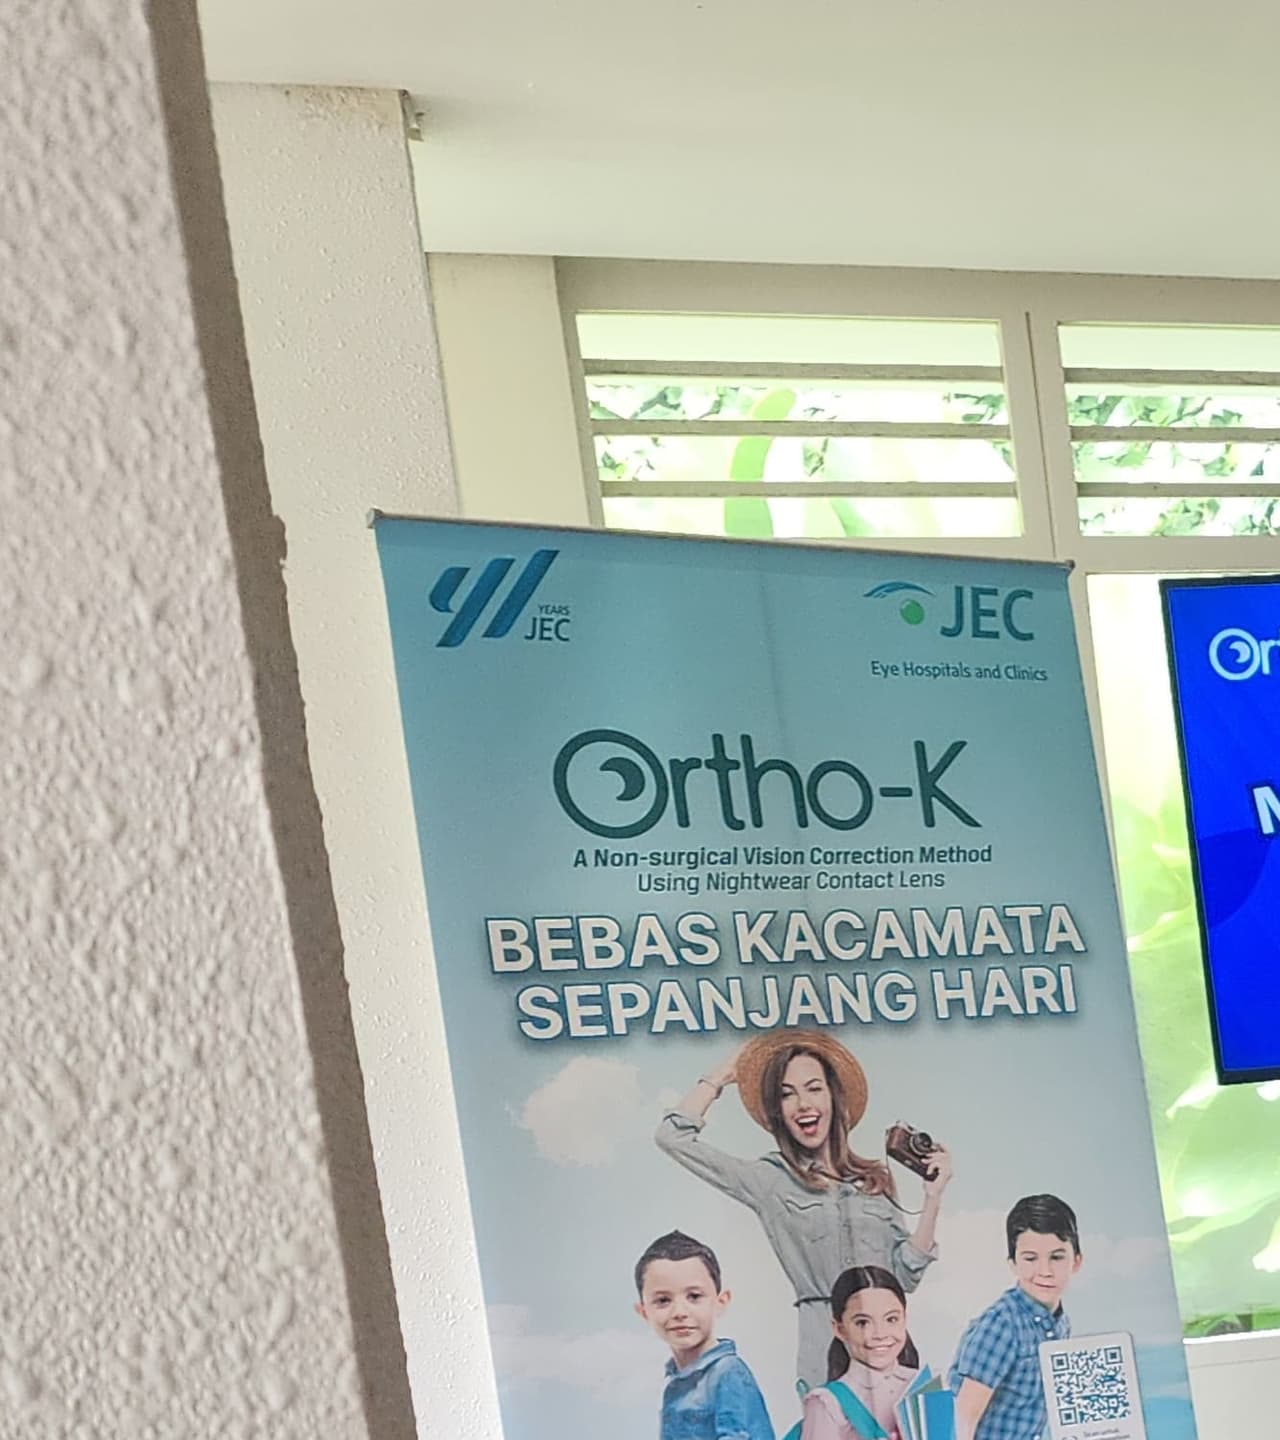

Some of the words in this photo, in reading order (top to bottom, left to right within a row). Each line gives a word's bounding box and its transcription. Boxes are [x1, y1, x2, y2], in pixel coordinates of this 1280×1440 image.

[538, 604, 570, 615] YEARS
[940, 585, 1034, 641] JEC
[524, 617, 570, 641] JEC
[871, 661, 899, 678] Eye
[904, 662, 971, 679] Hospitals
[976, 665, 1000, 679] and
[1005, 665, 1048, 681] Clinics
[553, 729, 983, 839] Ortho-K
[573, 849, 588, 867] A
[594, 847, 738, 868] Non-surgical
[743, 847, 804, 865] Vision
[809, 847, 914, 864] Correction
[919, 845, 992, 863] Method
[637, 872, 698, 894] Using
[706, 871, 810, 893] Nightwear
[816, 870, 894, 890] Contact
[899, 870, 945, 887] Lens
[485, 910, 721, 973] BEBAS
[734, 904, 1086, 963] KACAMATA
[517, 973, 918, 1041] SEPANJANG
[935, 966, 1078, 1020] HARI
